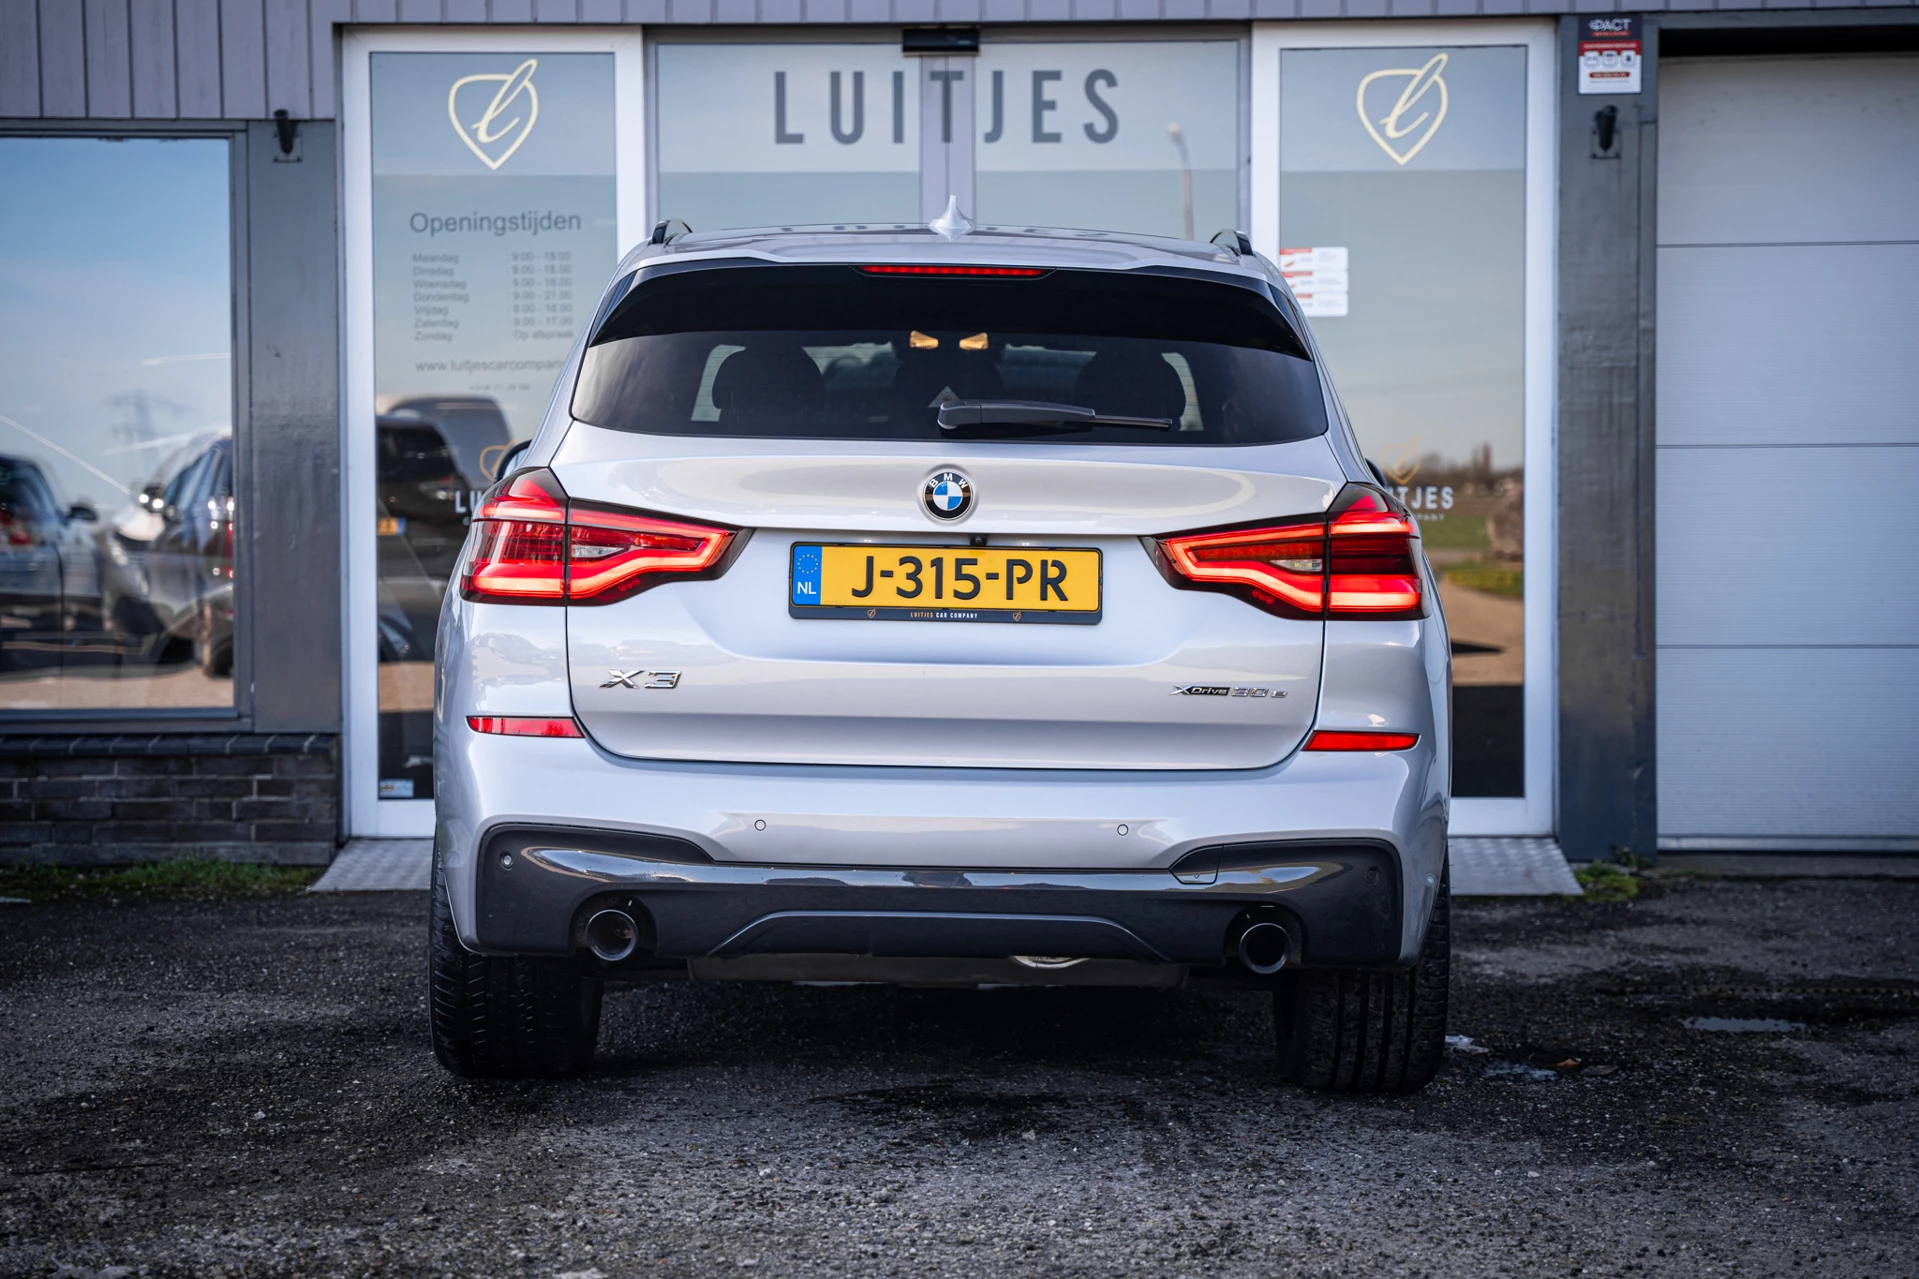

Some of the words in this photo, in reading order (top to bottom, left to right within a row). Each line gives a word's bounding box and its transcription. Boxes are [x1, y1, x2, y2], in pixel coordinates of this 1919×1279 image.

[774, 68, 1120, 145] LUITJES
[410, 211, 582, 237] Openingstijden
[412, 253, 460, 264] Maandag
[413, 266, 455, 277] Dinsdag
[413, 305, 449, 316] Vrijdag
[415, 331, 453, 342] Zondag
[415, 358, 564, 374] www.luitjescarcompan
[851, 555, 1069, 602] J-315-PR
[797, 582, 816, 595] NL
[910, 611, 934, 619] LUITJES
[598, 669, 682, 689] X3
